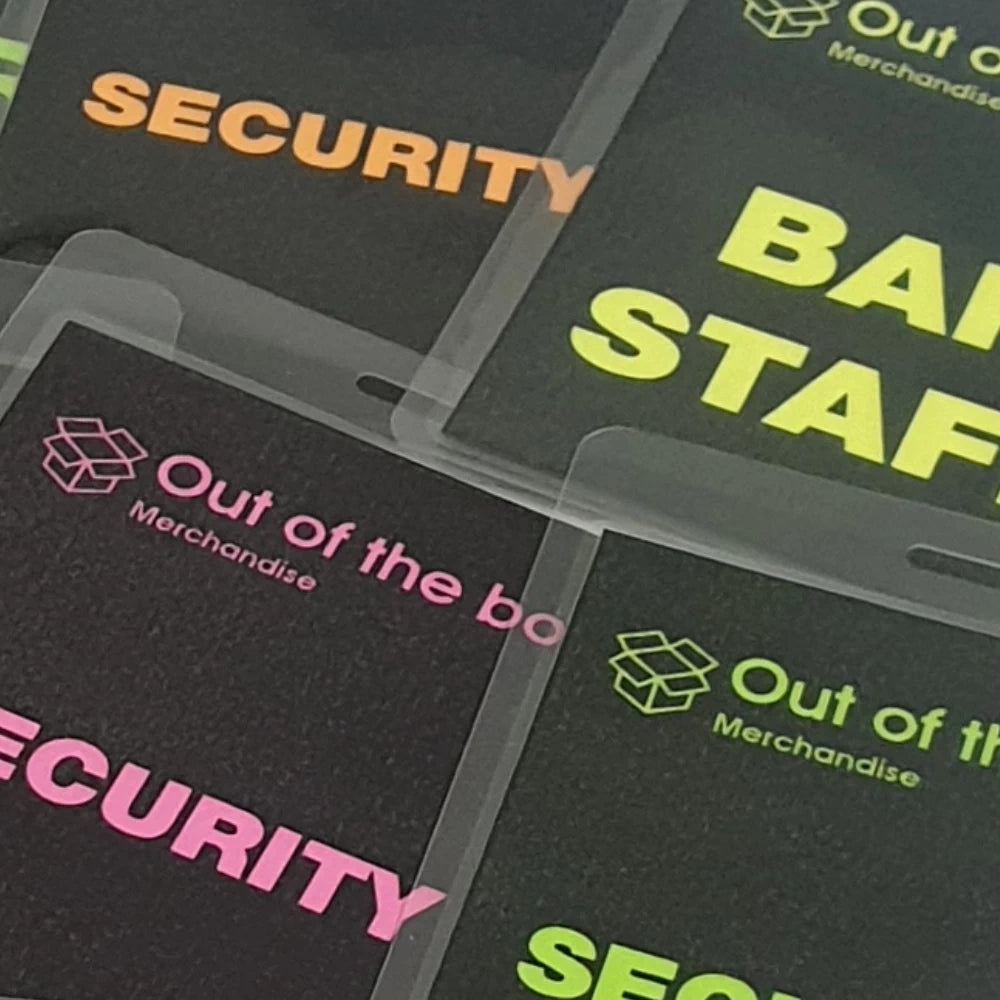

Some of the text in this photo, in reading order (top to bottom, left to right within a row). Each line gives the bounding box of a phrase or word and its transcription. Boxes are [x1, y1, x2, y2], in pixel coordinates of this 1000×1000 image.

[847, 0, 958, 60] Out
[82, 72, 595, 215] SECURITY
[569, 287, 1000, 508] STAF
[129, 499, 318, 593] Merchandise
[156, 454, 273, 529] Out
[283, 515, 352, 559] of
[360, 537, 463, 606] the
[711, 711, 922, 789] Merchandise
[730, 657, 857, 728] Out
[872, 706, 948, 752] of
